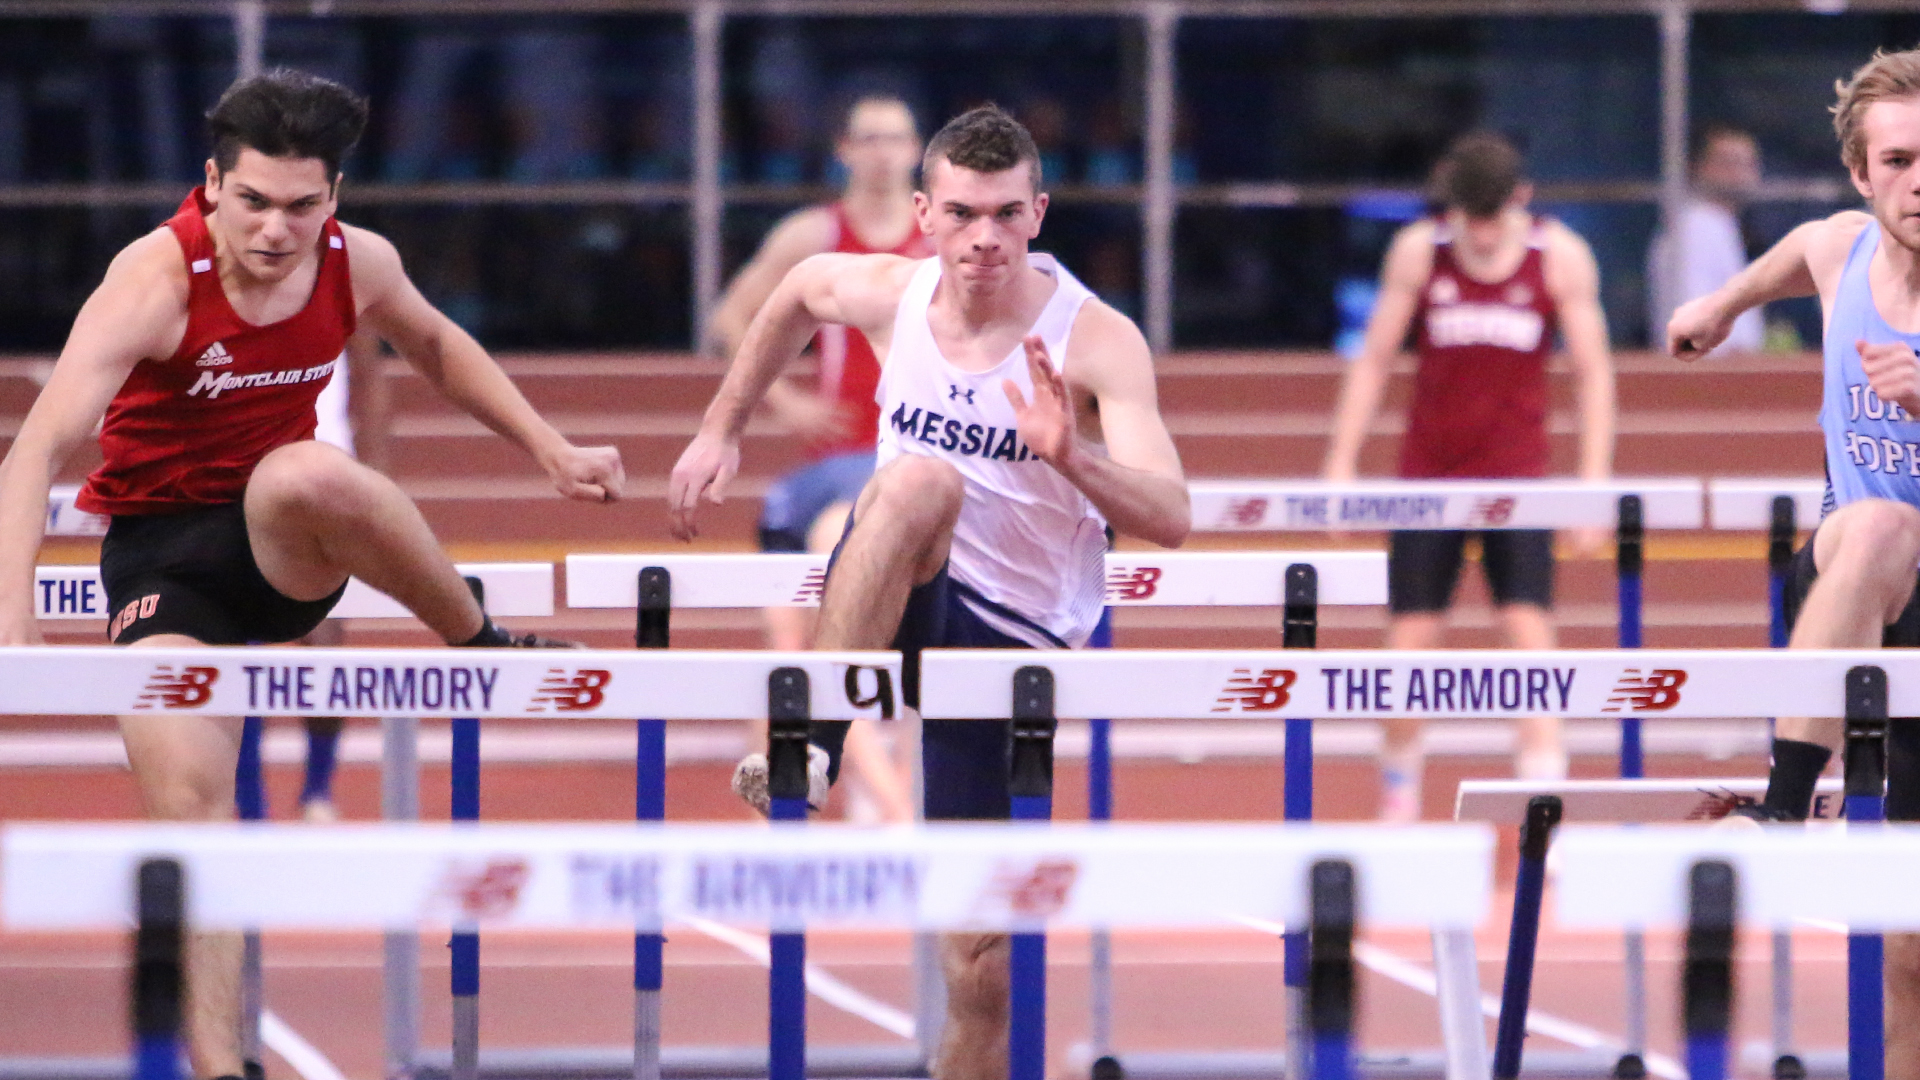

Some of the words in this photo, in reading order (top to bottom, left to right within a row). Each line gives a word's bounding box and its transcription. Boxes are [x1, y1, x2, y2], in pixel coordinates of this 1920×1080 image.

[195, 355, 234, 367] adidas
[891, 402, 1040, 463] MESSIA
[39, 580, 97, 614] THE
[243, 666, 315, 709] THE
[328, 667, 499, 711] ARMORY
[1320, 668, 1393, 711] THE
[1405, 668, 1577, 712] ARMORY
